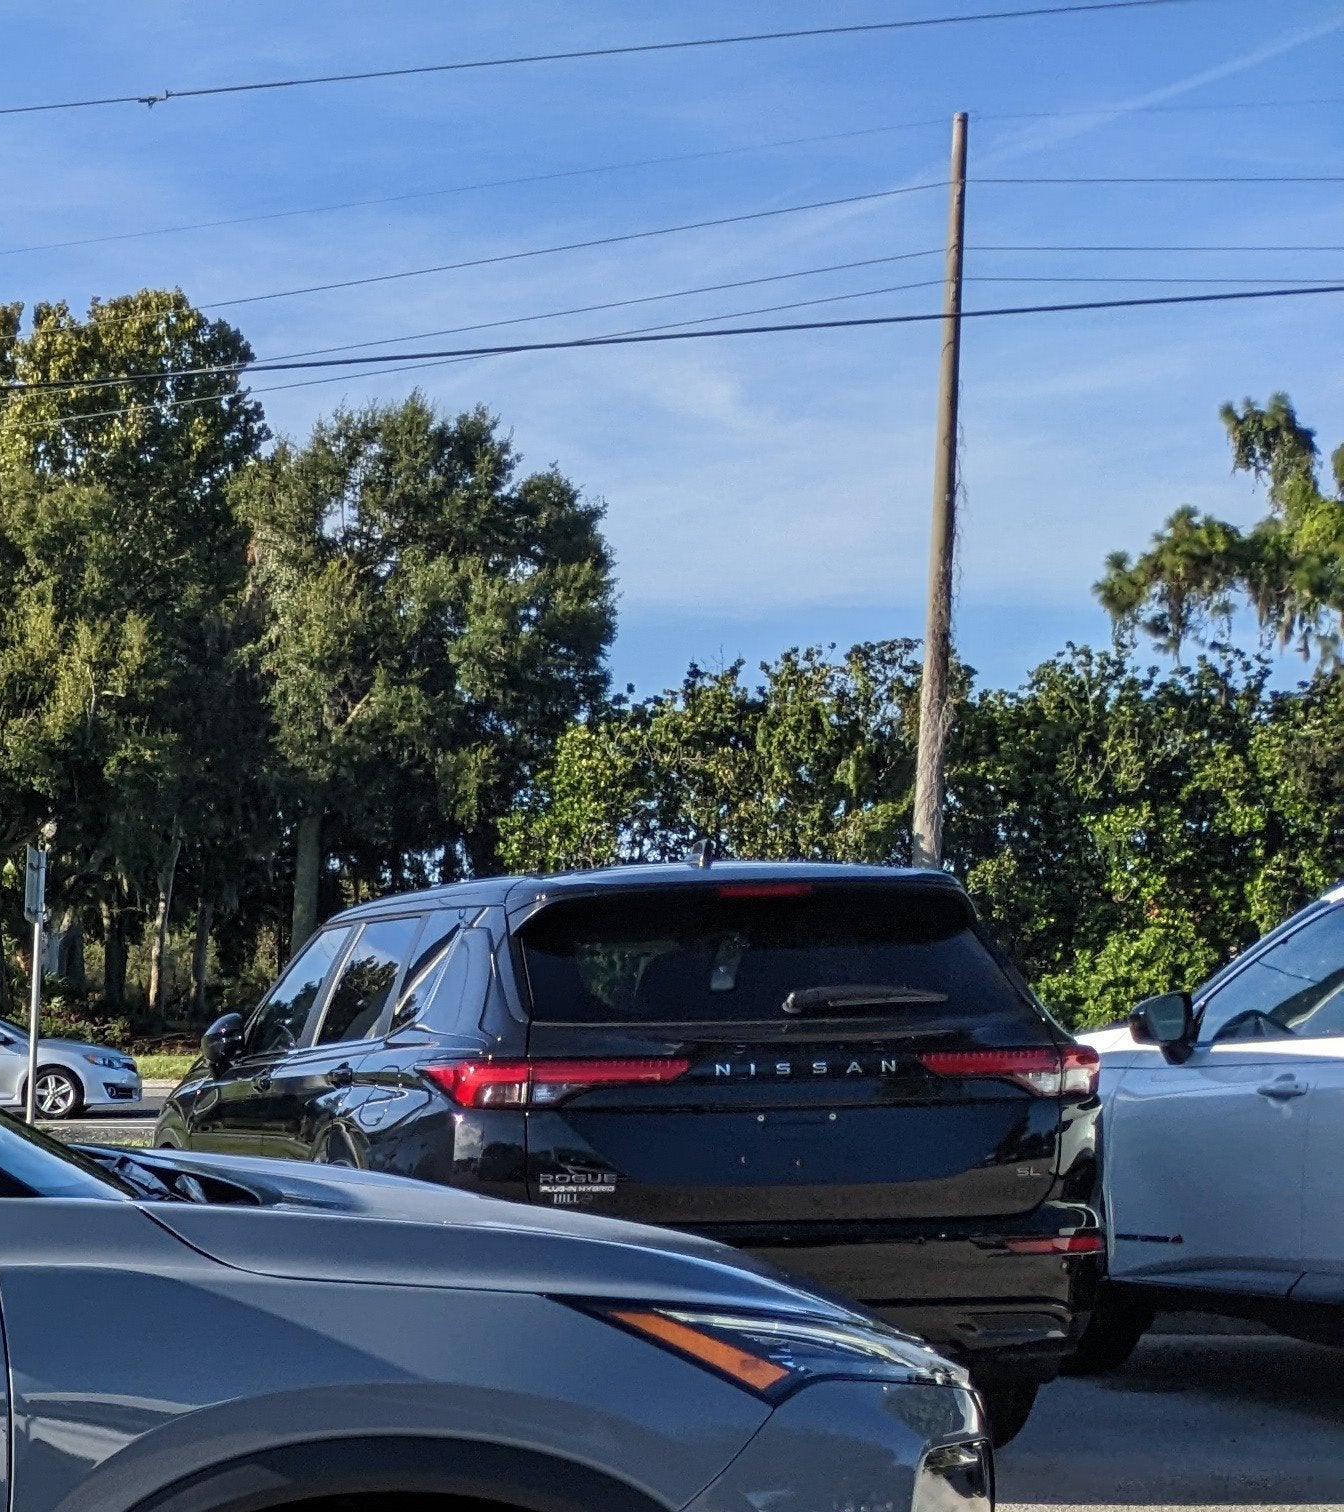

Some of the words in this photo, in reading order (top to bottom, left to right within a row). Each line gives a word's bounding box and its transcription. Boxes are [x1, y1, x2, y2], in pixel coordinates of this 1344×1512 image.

[714, 1059, 897, 1076] NISSAN
[1016, 1167, 1041, 1176] SL
[539, 1173, 617, 1184] ROGUE
